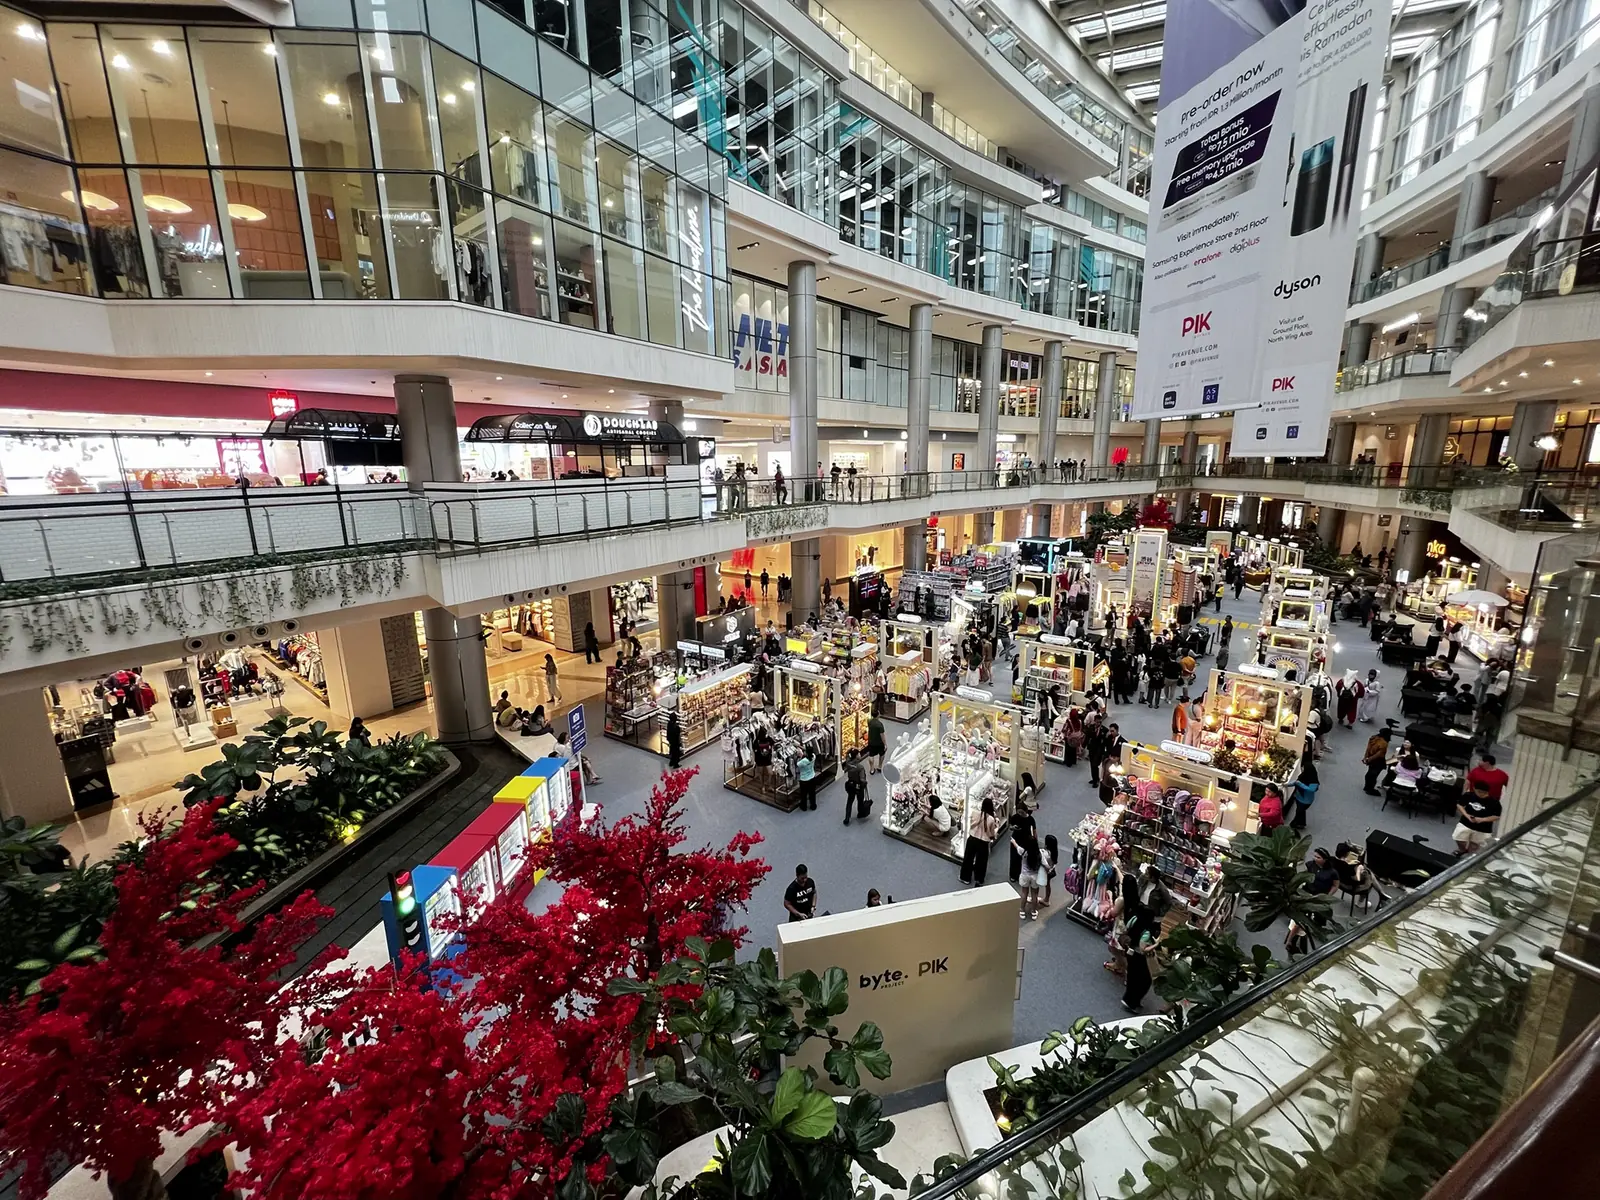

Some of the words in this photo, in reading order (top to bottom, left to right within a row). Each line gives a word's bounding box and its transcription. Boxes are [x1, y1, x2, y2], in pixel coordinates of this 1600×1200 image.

[1313, 8, 1373, 52] Ramadan
[1180, 82, 1234, 125] Pre-order
[1235, 60, 1265, 88] now
[1164, 127, 1189, 147] Starting
[1190, 116, 1207, 131] from
[1207, 108, 1219, 119] IDR
[1229, 67, 1284, 106] Million/month
[1200, 130, 1220, 148] Total
[1220, 117, 1245, 136] Bonus
[1176, 175, 1191, 188] Free
[1191, 159, 1222, 179] memory
[1222, 140, 1256, 163] upgrade
[1225, 158, 1244, 171] mio
[1176, 232, 1192, 242] Visit
[1192, 211, 1240, 236] immediately:
[1152, 252, 1179, 268] Samsung
[1179, 240, 1215, 258] Experience
[1215, 231, 1233, 243] Store
[1234, 224, 1248, 236] 2nd
[1249, 216, 1270, 229] Floor
[1229, 236, 1261, 254] digiplus
[1273, 274, 1321, 299] dyson
[1182, 311, 1212, 337] PIK
[1273, 326, 1293, 335] Ground
[1299, 330, 1313, 338] Area
[1172, 344, 1218, 358] PIKAVENUE.COM
[1272, 376, 1295, 392] PIK
[860, 969, 909, 991] byte.
[918, 956, 949, 977] PIK
[880, 981, 905, 989] PROJECT
